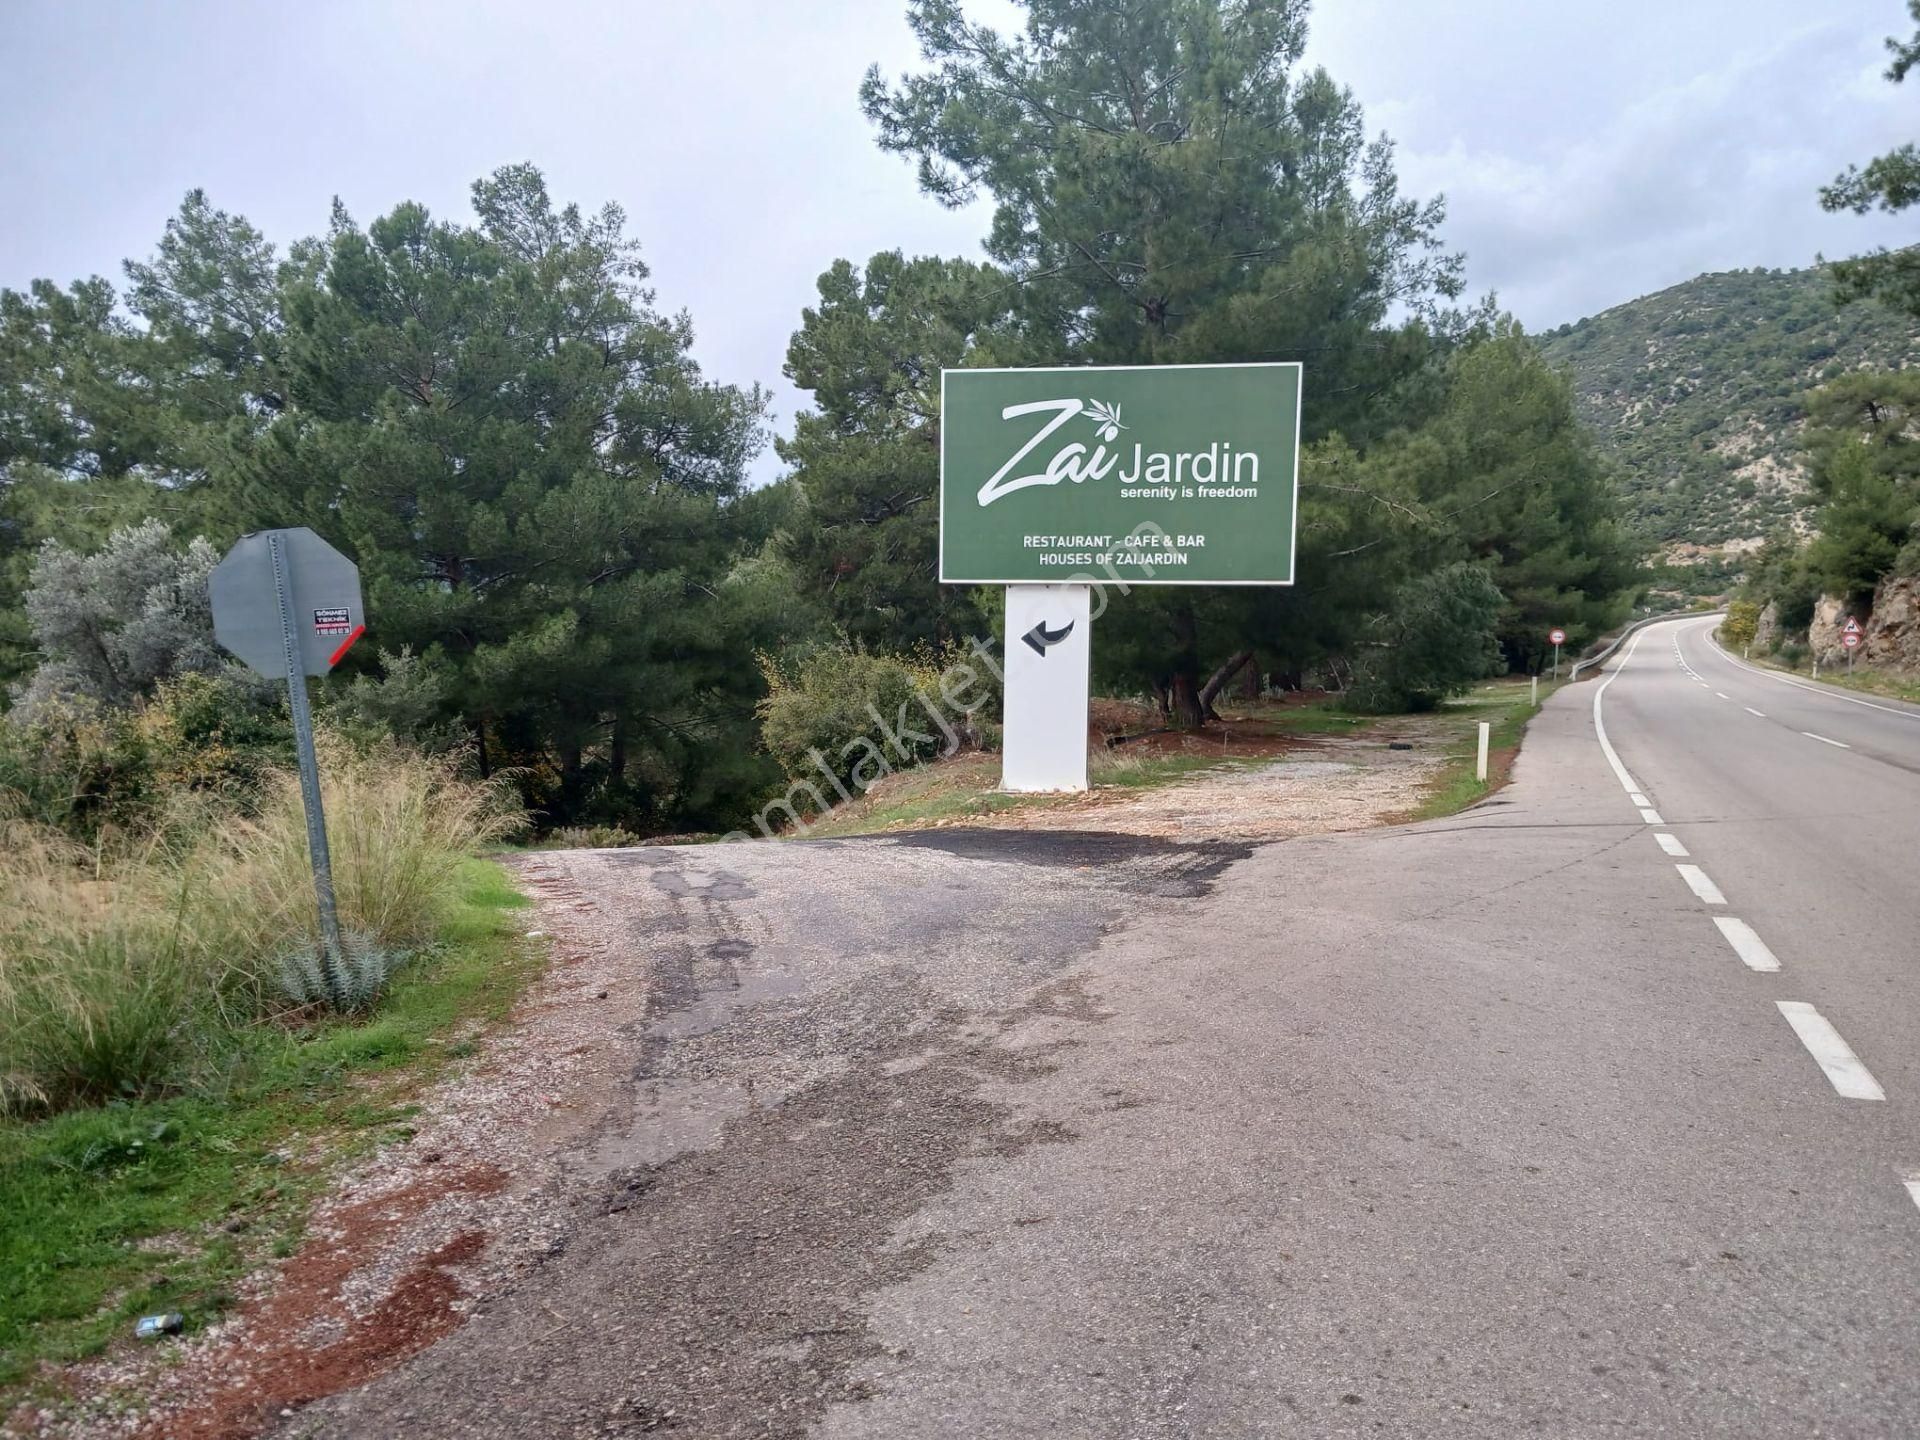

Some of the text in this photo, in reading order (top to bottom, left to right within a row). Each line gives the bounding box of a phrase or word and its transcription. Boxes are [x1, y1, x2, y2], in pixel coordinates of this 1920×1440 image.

[977, 398, 1259, 507] Zai Jardin
[1120, 485, 1258, 501] serenity is freedom
[1023, 536, 1112, 548] RESTAURANT
[1124, 535, 1160, 548] CAFE
[1163, 536, 1174, 547] &
[1177, 535, 1206, 547] BAR
[1039, 553, 1188, 566] HOUSES OF ZAIJARDIN
